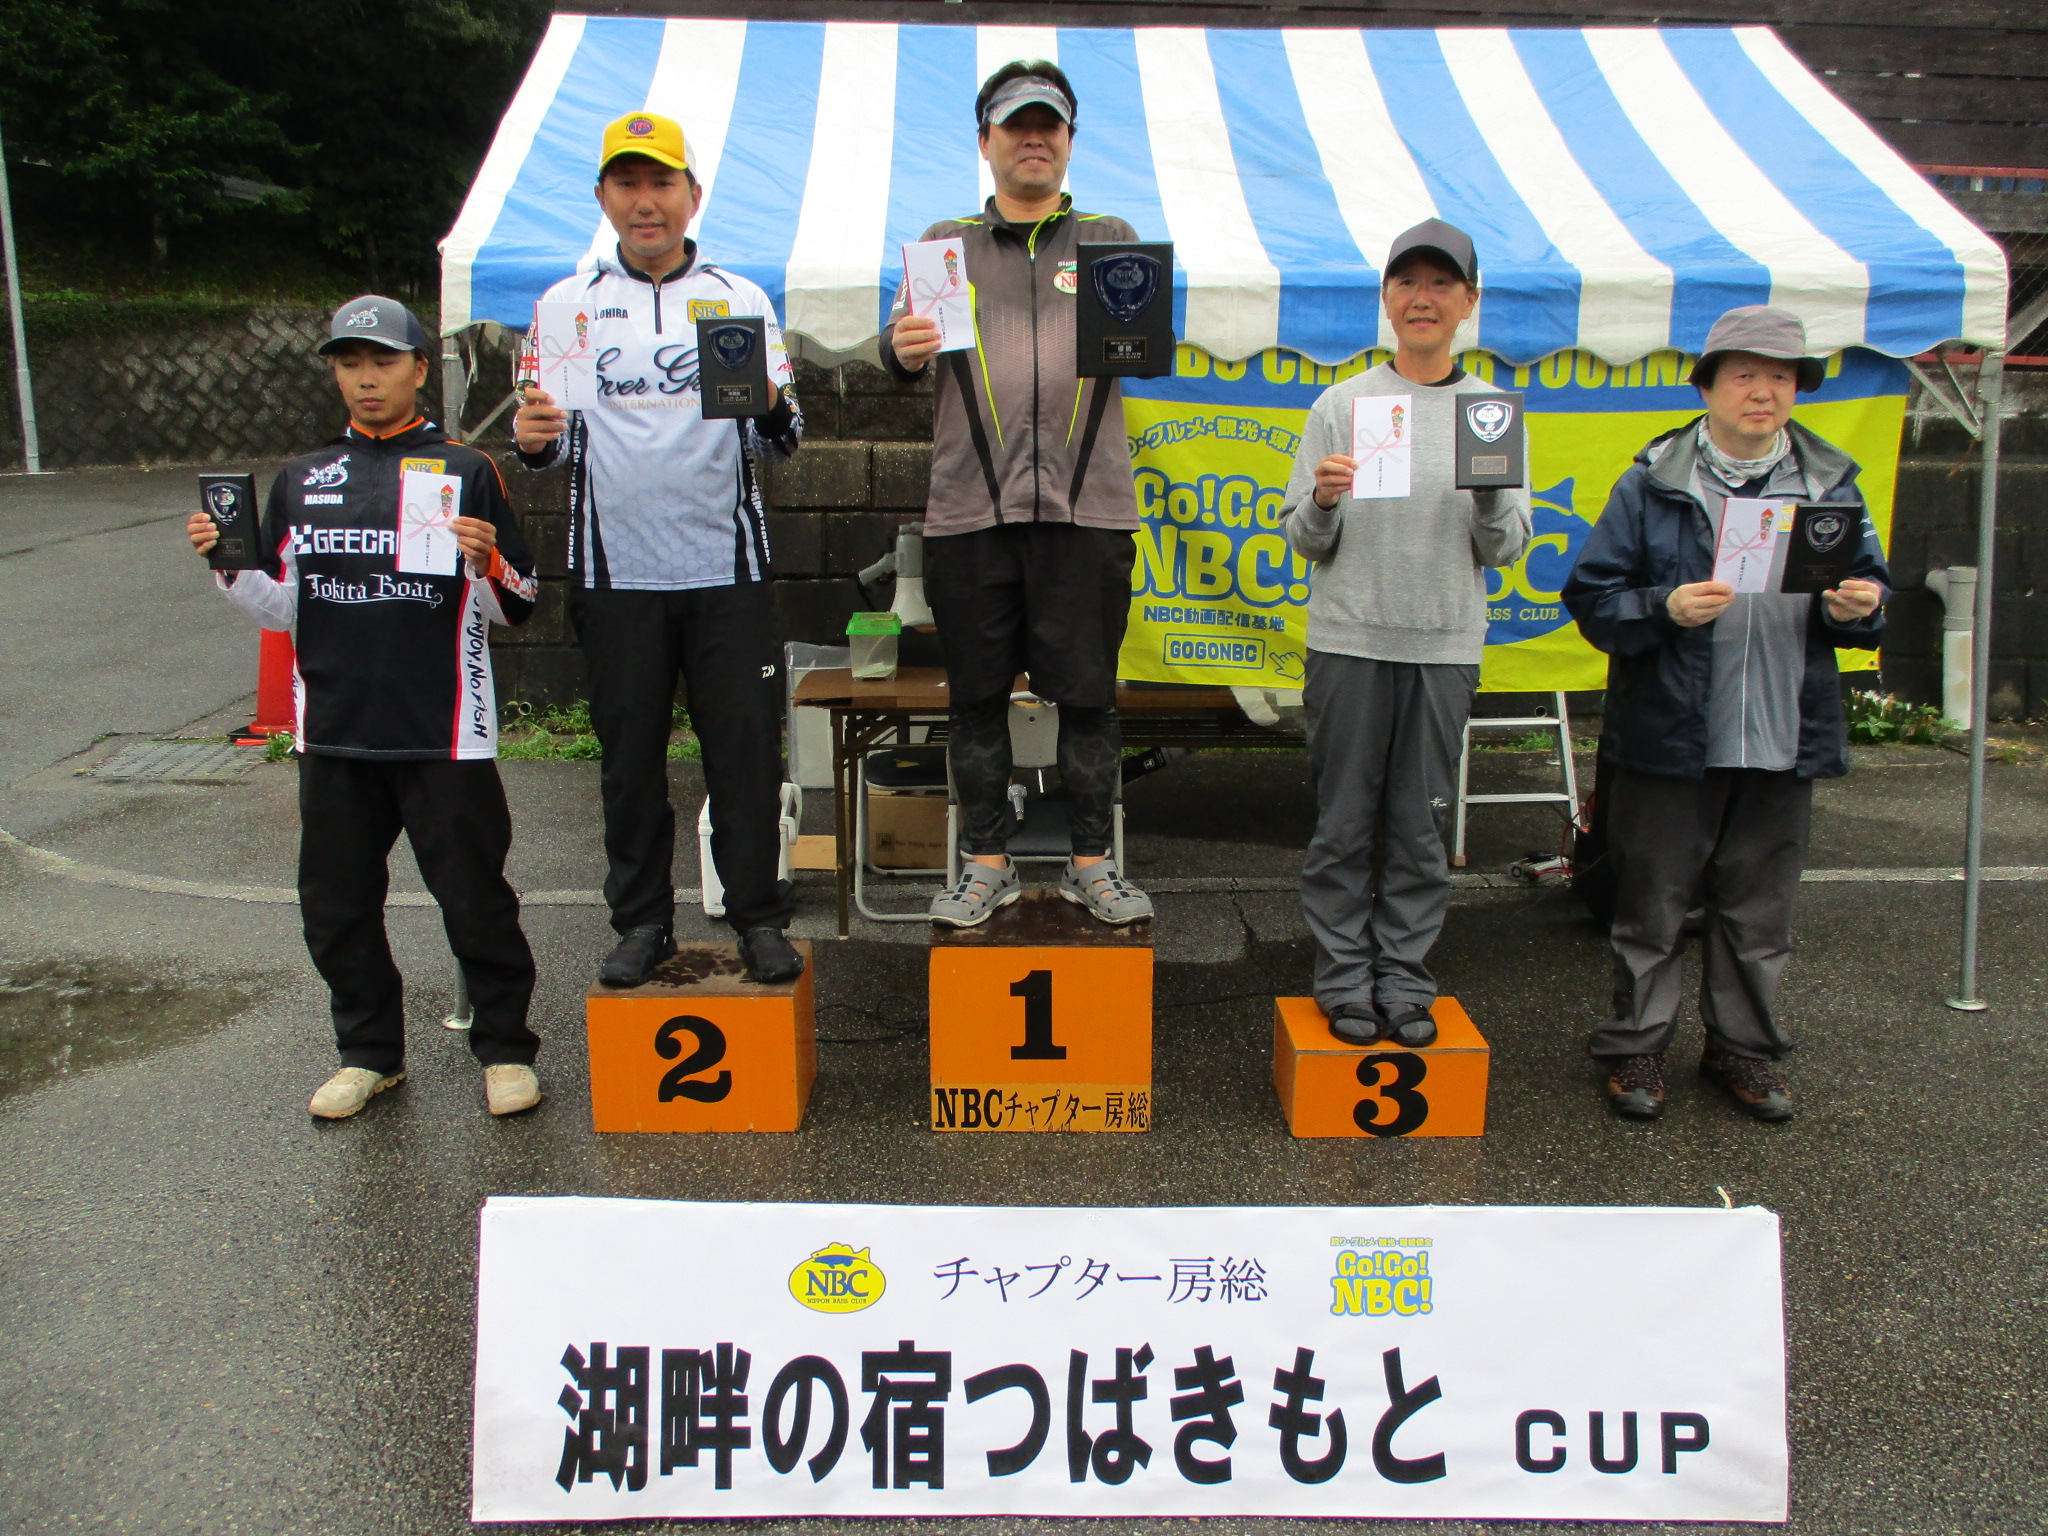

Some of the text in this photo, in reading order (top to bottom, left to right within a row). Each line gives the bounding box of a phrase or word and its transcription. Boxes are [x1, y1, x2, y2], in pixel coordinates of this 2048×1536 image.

[609, 397, 701, 411] INTERNATION
[304, 494, 344, 505] MASUDA
[1134, 473, 1287, 530] Go!Go
[313, 529, 400, 555] GEECR
[305, 573, 433, 600] Tokita Boat
[1144, 605, 1285, 632] NBC動画配信基地
[1486, 607, 1560, 621] ASS CLUB
[1170, 640, 1258, 663] GOGONBC
[1009, 970, 1067, 1060] 1
[655, 1016, 732, 1104] 2
[1352, 1053, 1429, 1137] 3
[1337, 1250, 1429, 1277] Go!Go!
[805, 1270, 869, 1297] NBC
[934, 1255, 1268, 1304] チャプター房総
[1331, 1277, 1432, 1316] NBC!
[555, 1340, 1449, 1494] 湖畔の宿つばきもと
[1514, 1409, 1711, 1475] CUP
